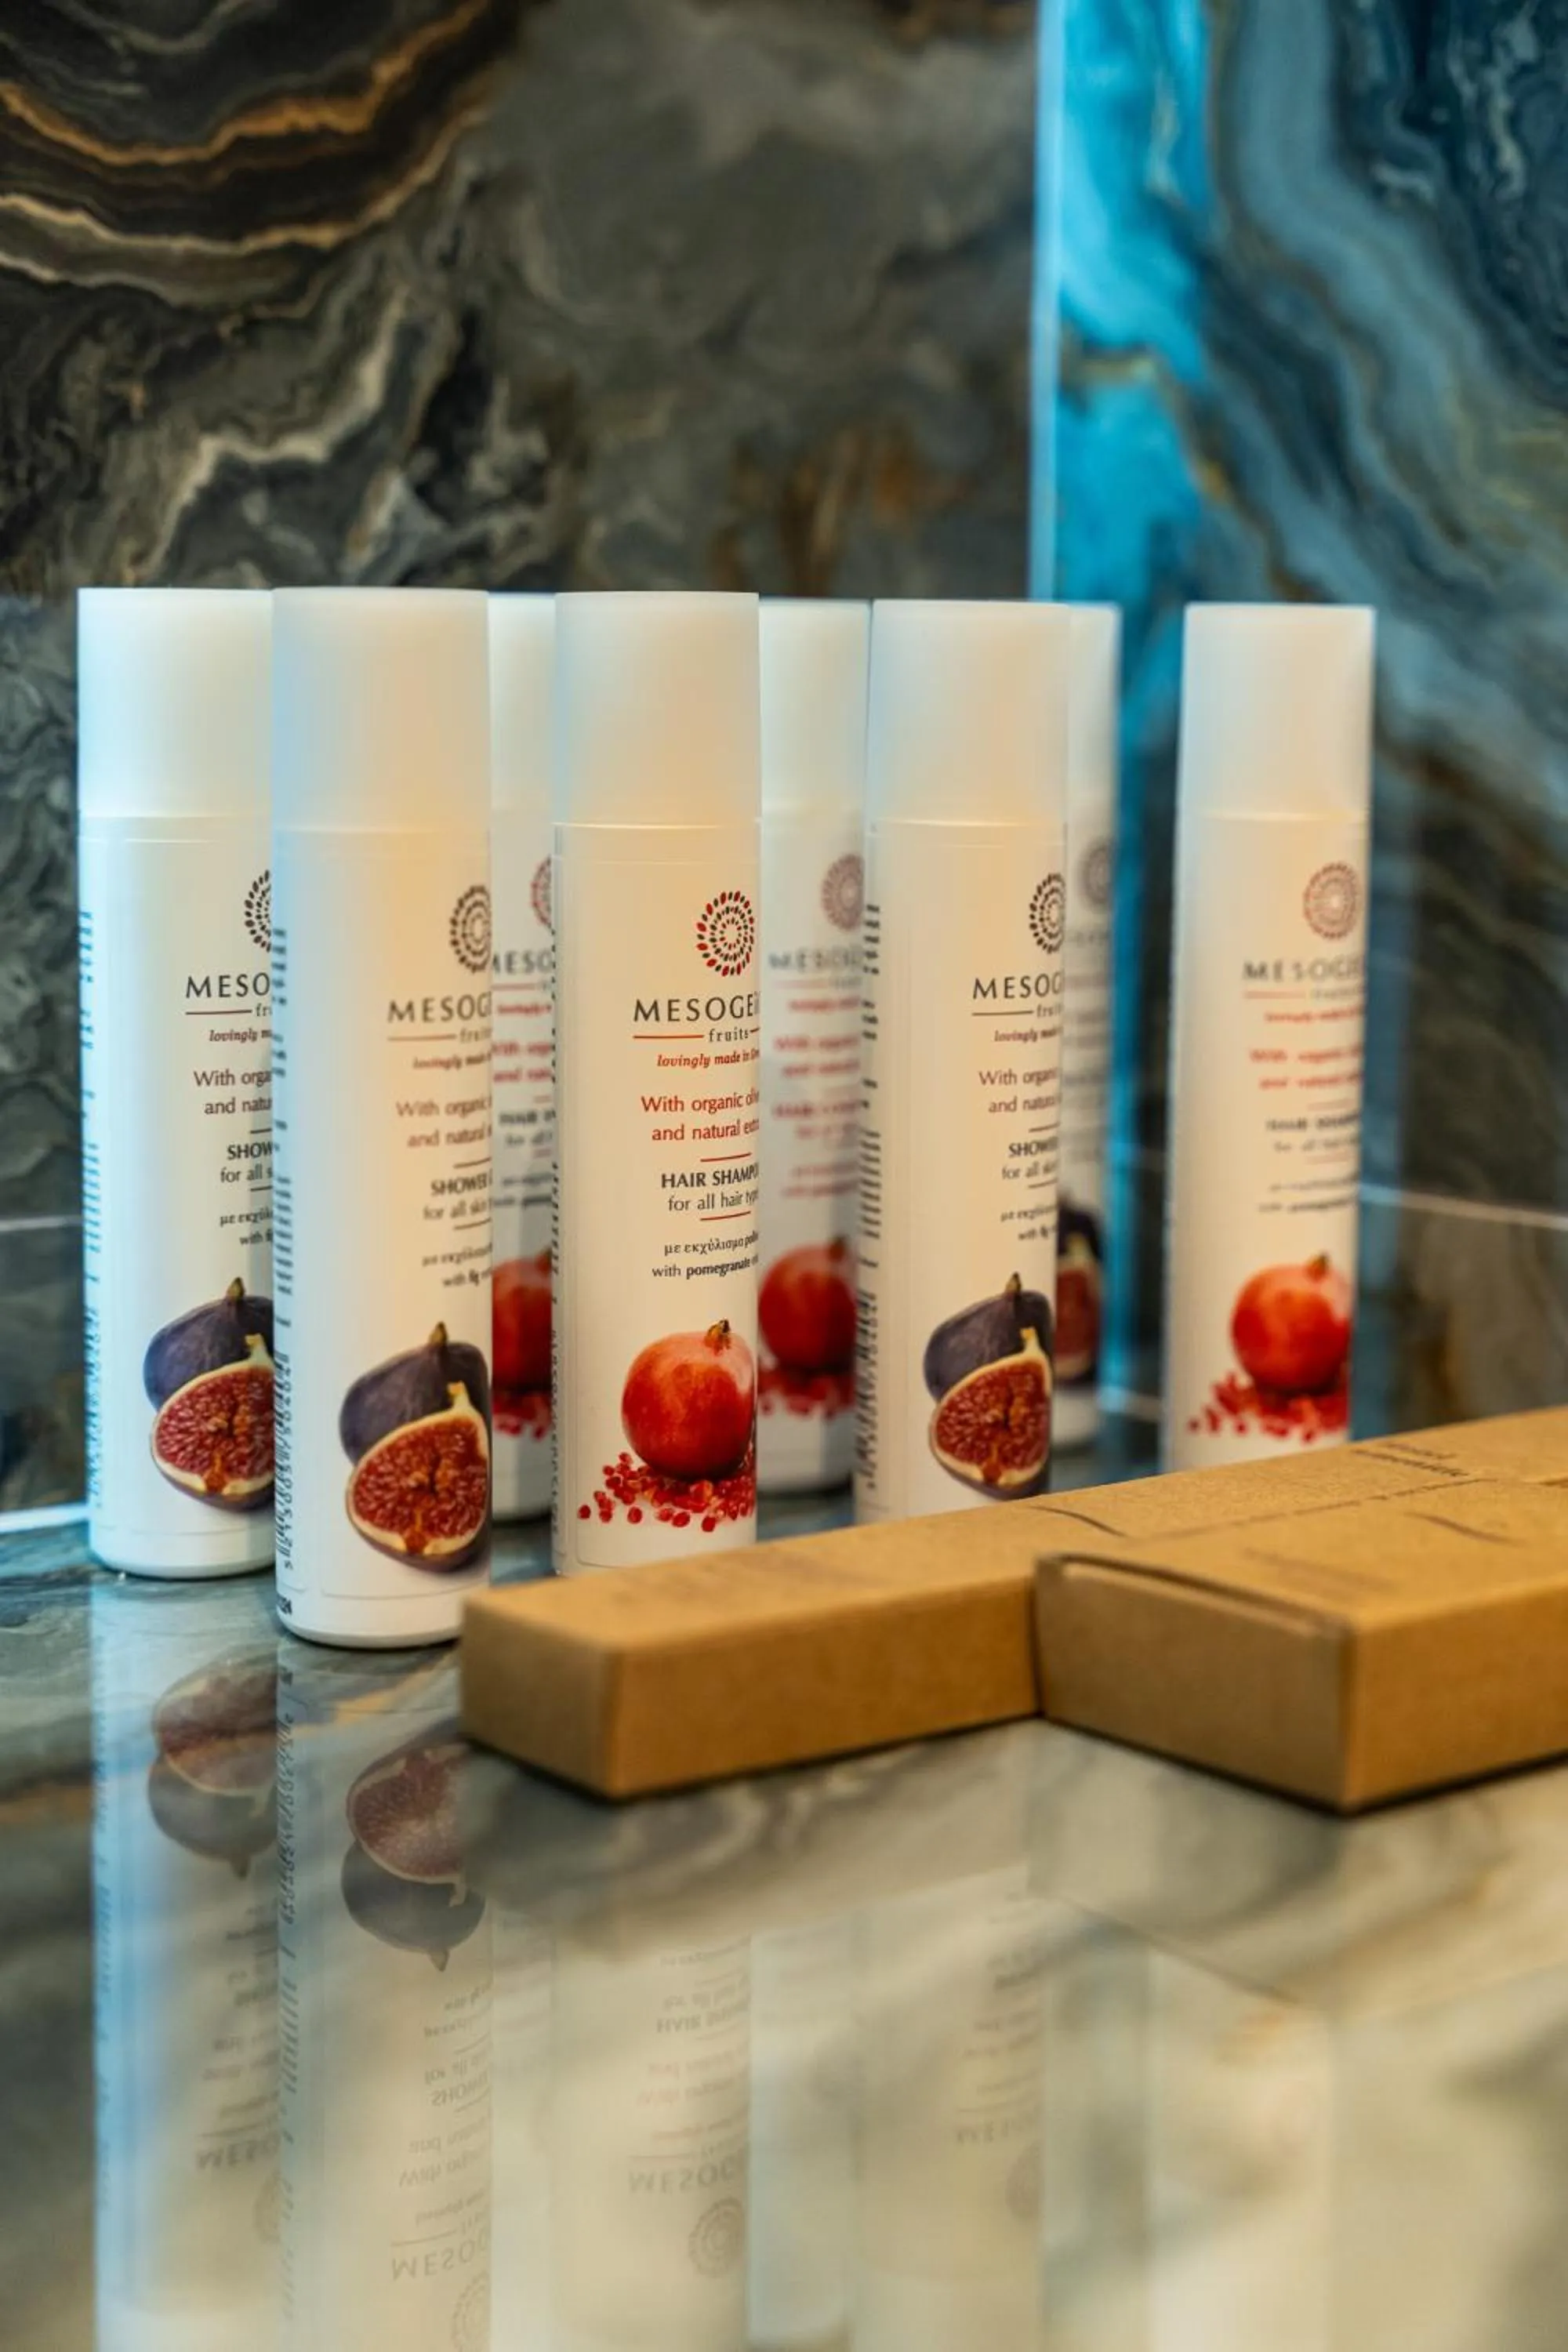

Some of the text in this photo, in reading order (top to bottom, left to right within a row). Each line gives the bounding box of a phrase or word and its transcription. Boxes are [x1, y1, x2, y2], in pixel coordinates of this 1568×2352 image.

[186, 972, 270, 998] MESO
[709, 1027, 749, 1043] fruits
[656, 1052, 710, 1069] lovingly
[714, 1050, 741, 1065] made
[193, 1069, 235, 1087] With
[978, 1069, 1018, 1086] With
[204, 1097, 236, 1115] and
[396, 1098, 440, 1117] With
[641, 1095, 685, 1113] With
[691, 1091, 743, 1115] organic
[988, 1095, 1017, 1113] and
[407, 1127, 439, 1148] and
[652, 1123, 684, 1141] and
[691, 1119, 740, 1140] natural
[220, 1166, 241, 1183] for
[662, 1172, 706, 1189] HAIR
[667, 1195, 691, 1211] for
[697, 1193, 715, 1211] all
[720, 1191, 743, 1208] hair
[652, 1264, 681, 1277] with
